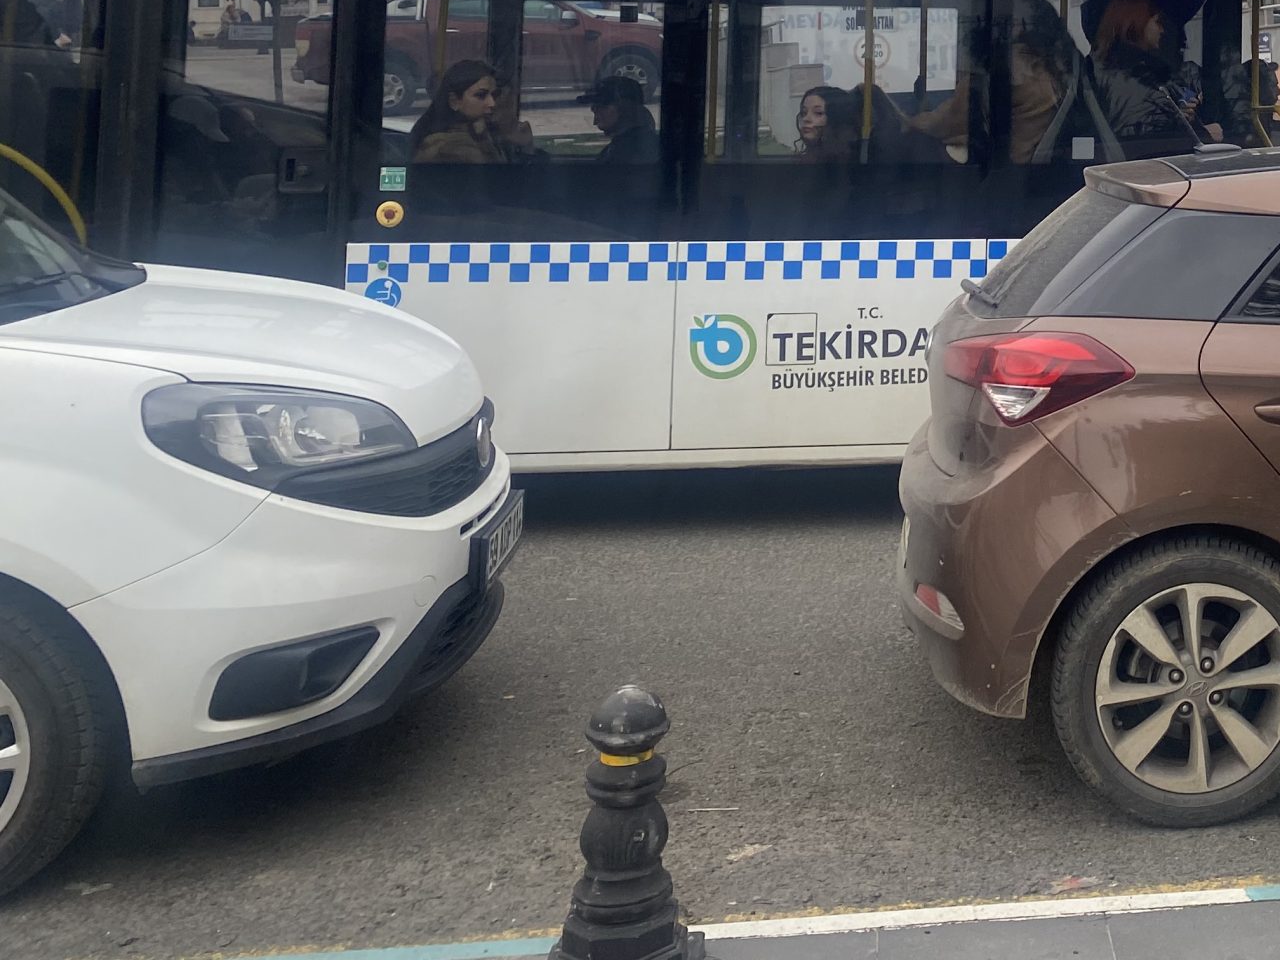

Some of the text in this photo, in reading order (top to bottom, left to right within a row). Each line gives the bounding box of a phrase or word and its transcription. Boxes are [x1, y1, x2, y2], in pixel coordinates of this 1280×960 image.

[784, 11, 841, 29] MEYDA
[858, 307, 883, 319] T.C.
[772, 324, 928, 362] TEKİRDA
[772, 366, 928, 392] BÜYÜKŞEHİR BELED
